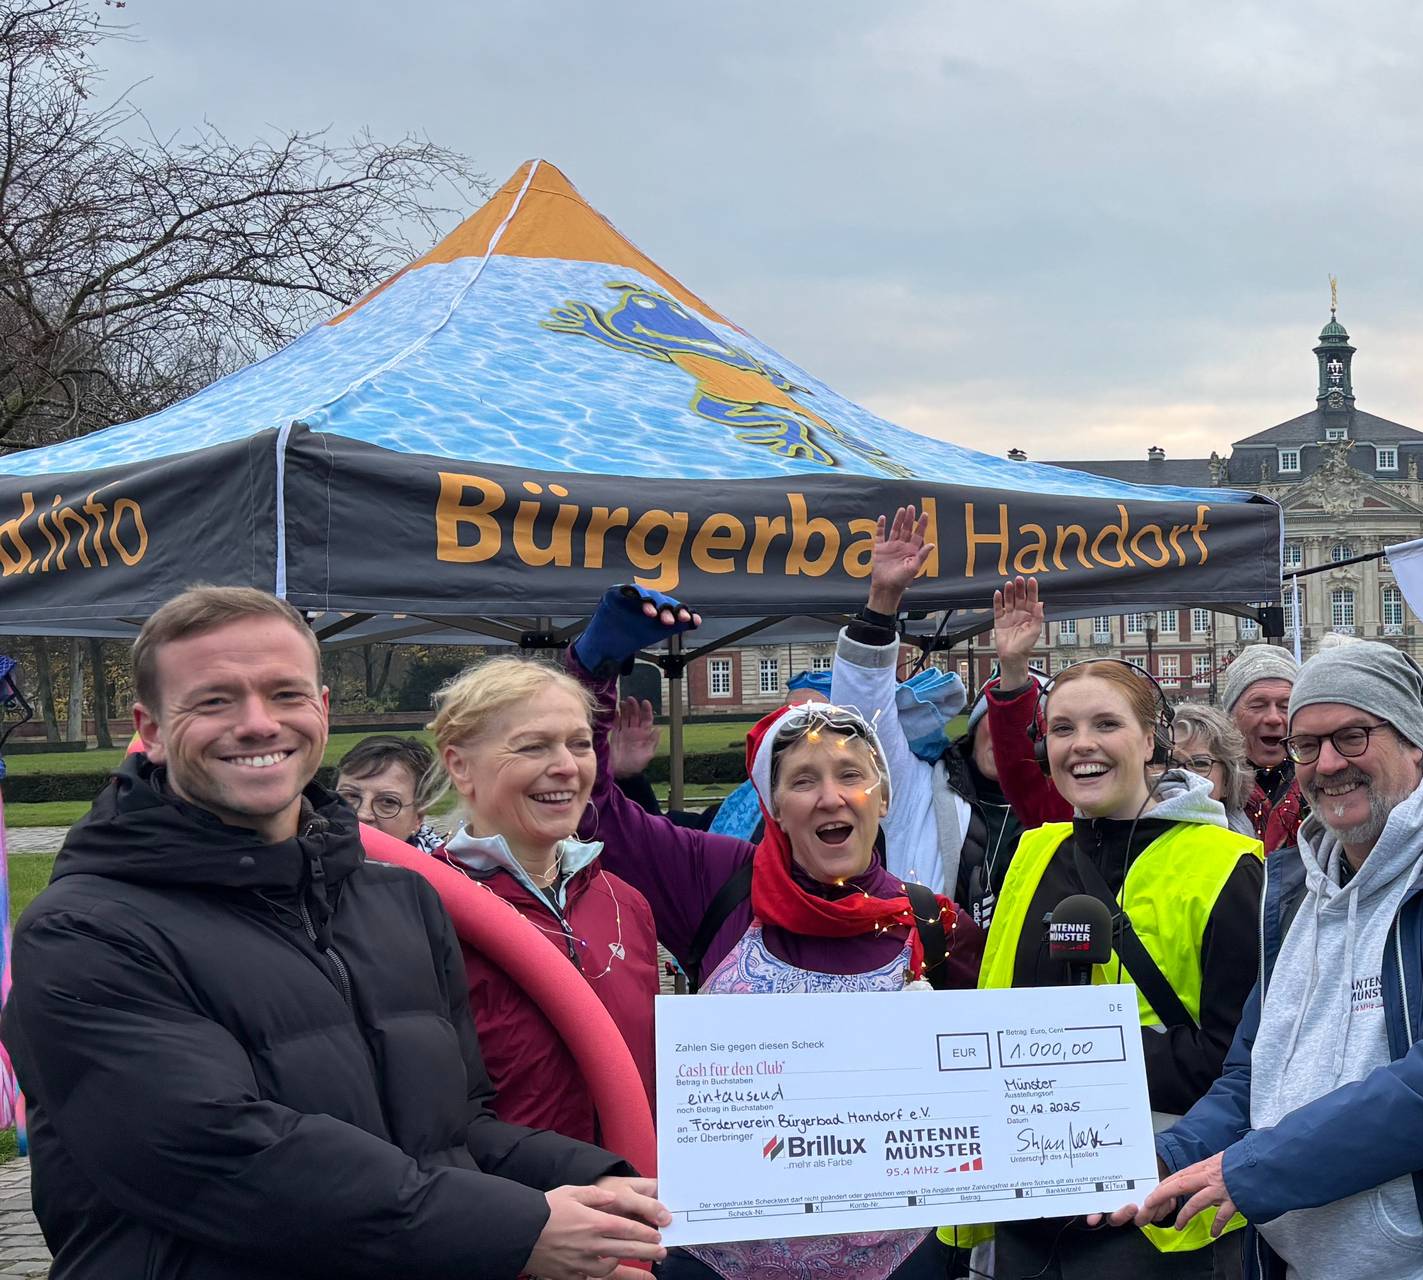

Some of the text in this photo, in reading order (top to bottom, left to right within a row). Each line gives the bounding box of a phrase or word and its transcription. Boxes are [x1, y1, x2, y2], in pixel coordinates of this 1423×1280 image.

[0, 480, 149, 577] d.info
[965, 503, 1211, 579] Handorf
[1048, 1026, 1064, 1034] Cent
[675, 1040, 824, 1053] Zahlen Sie gegen diesen Scheck
[952, 1047, 977, 1058] EUR
[1010, 1041, 1093, 1061] 1.000,00
[710, 1061, 730, 1076] für
[731, 1061, 754, 1076] den
[676, 1076, 754, 1088] Betrag in Buchstaben
[1004, 1077, 1057, 1091] Münster
[687, 1083, 784, 1106] eintausend
[676, 1106, 695, 1114] noch
[697, 1105, 721, 1115] Betrag
[730, 1103, 774, 1112] Buchstaben
[690, 1113, 775, 1133] Förderverein
[777, 1112, 844, 1135] Bürgerbad
[847, 1107, 904, 1125] Handorf
[1007, 1116, 1029, 1125] Datum
[677, 1125, 688, 1133] an
[884, 1125, 981, 1144] ANTENNE
[676, 1131, 754, 1145] oder Überbringer
[788, 1134, 867, 1158] Brillux
[885, 1141, 982, 1161] MÜNSTER
[813, 1158, 826, 1168] als
[827, 1156, 853, 1167] Farbe
[886, 1165, 940, 1177] 95.4 MHz
